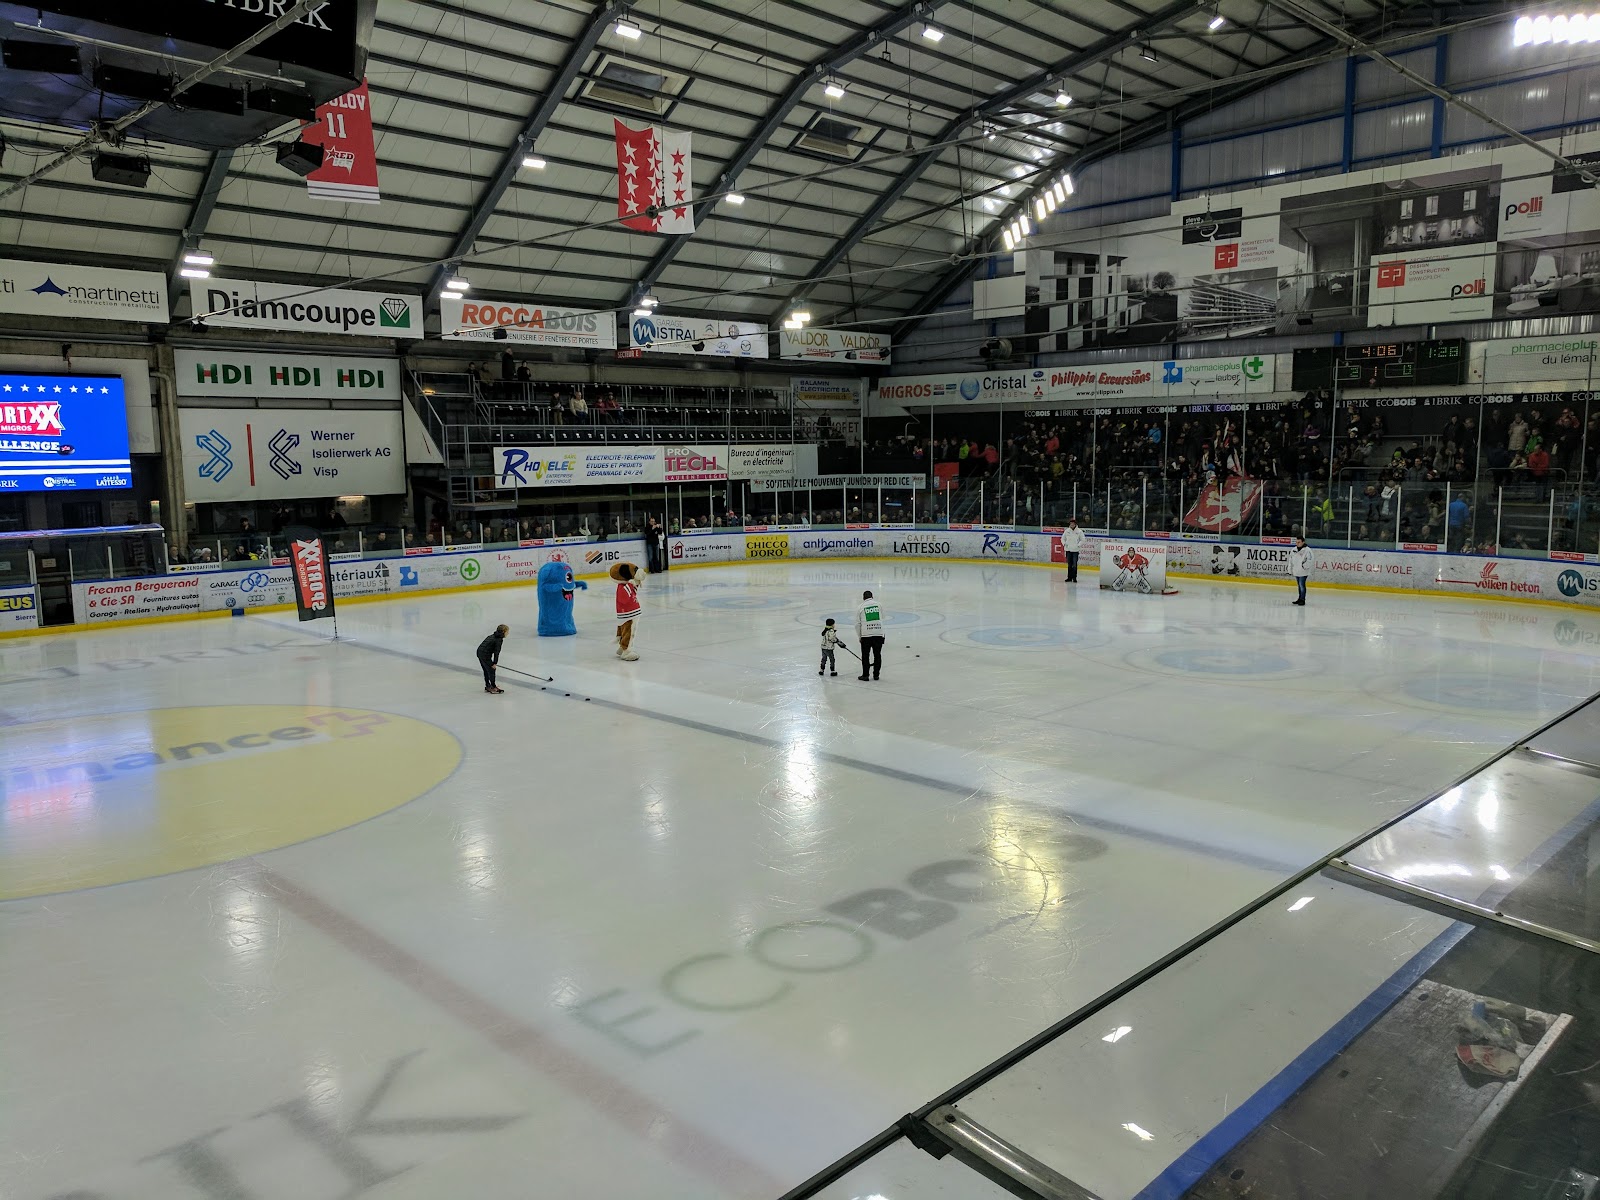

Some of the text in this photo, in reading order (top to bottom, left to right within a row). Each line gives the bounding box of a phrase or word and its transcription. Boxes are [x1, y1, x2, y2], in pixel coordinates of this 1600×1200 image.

[326, 112, 347, 138] 11
[1505, 196, 1543, 221] polli
[1409, 267, 1450, 276] CONSTRUCTION
[68, 285, 160, 304] martinetti
[1450, 279, 1486, 300] polli
[68, 299, 118, 307] construction
[207, 289, 376, 332] Diamcoupe
[461, 303, 598, 333] ROCCABOIS
[655, 319, 684, 328] GARAGE
[468, 331, 495, 339] CUISINES
[544, 335, 572, 343] FENÊTRES
[578, 337, 599, 345] PORTES
[785, 331, 830, 347] VALDOR
[840, 334, 880, 348] VALDOR
[1362, 344, 1397, 357] 4:06
[1511, 340, 1598, 355] pharmacieplus
[1541, 353, 1597, 365] du léman
[1184, 362, 1241, 374] pharmacieplus
[196, 363, 385, 389] HDI HDI HDI
[983, 375, 1027, 390] Cristal
[1098, 371, 1151, 385] Excursions
[1215, 373, 1240, 382] lauber
[879, 384, 932, 399] MIGROS
[983, 391, 1018, 399] GARAGE
[1121, 407, 1142, 415] IBRIK
[1147, 406, 1177, 414] ECOBOIS
[1188, 404, 1211, 413] IBRIK
[1216, 403, 1250, 412] ECOBOIS
[1376, 398, 1417, 407] ECOBOIS
[1432, 396, 1462, 406] IBRIK
[1468, 395, 1514, 404] ECOBOIS
[1531, 392, 1564, 402] IBRIK
[0, 404, 64, 430] RTXX
[310, 430, 355, 441] Werner
[312, 447, 391, 459] Isolierwerk AG
[667, 448, 689, 456] PRO
[731, 449, 754, 457] Bureau
[665, 456, 717, 472] TECH
[752, 457, 784, 466] électricité
[313, 466, 338, 478] Visp
[800, 479, 806, 487] LE
[807, 478, 847, 487] MOUVEMENT
[847, 477, 871, 486] JUNIOR
[873, 477, 883, 486] DU
[884, 476, 897, 486] RED
[899, 476, 910, 486] ICE
[746, 541, 788, 549] CHICCO
[803, 537, 874, 551] anthamatten
[893, 541, 950, 554] LATTESSO
[1136, 546, 1165, 554] CHALLENGE
[497, 553, 511, 561] Les
[604, 551, 620, 561] IBC
[750, 549, 783, 558] D'ORO
[1247, 549, 1291, 561] MORE
[515, 568, 537, 577] sirops
[1315, 561, 1413, 575] LA VACHE QUI VOLE
[331, 569, 381, 582] atériaux
[88, 578, 199, 595] Freama Berguerand
[209, 576, 294, 589] GARAGE OLYMP
[357, 579, 389, 588] PLUS SA
[1510, 581, 1540, 593] beton
[89, 600, 97, 608] &
[100, 597, 118, 607] Cie
[120, 595, 135, 605] SA
[89, 603, 200, 618] Garage Ateliers Hydrauliques
